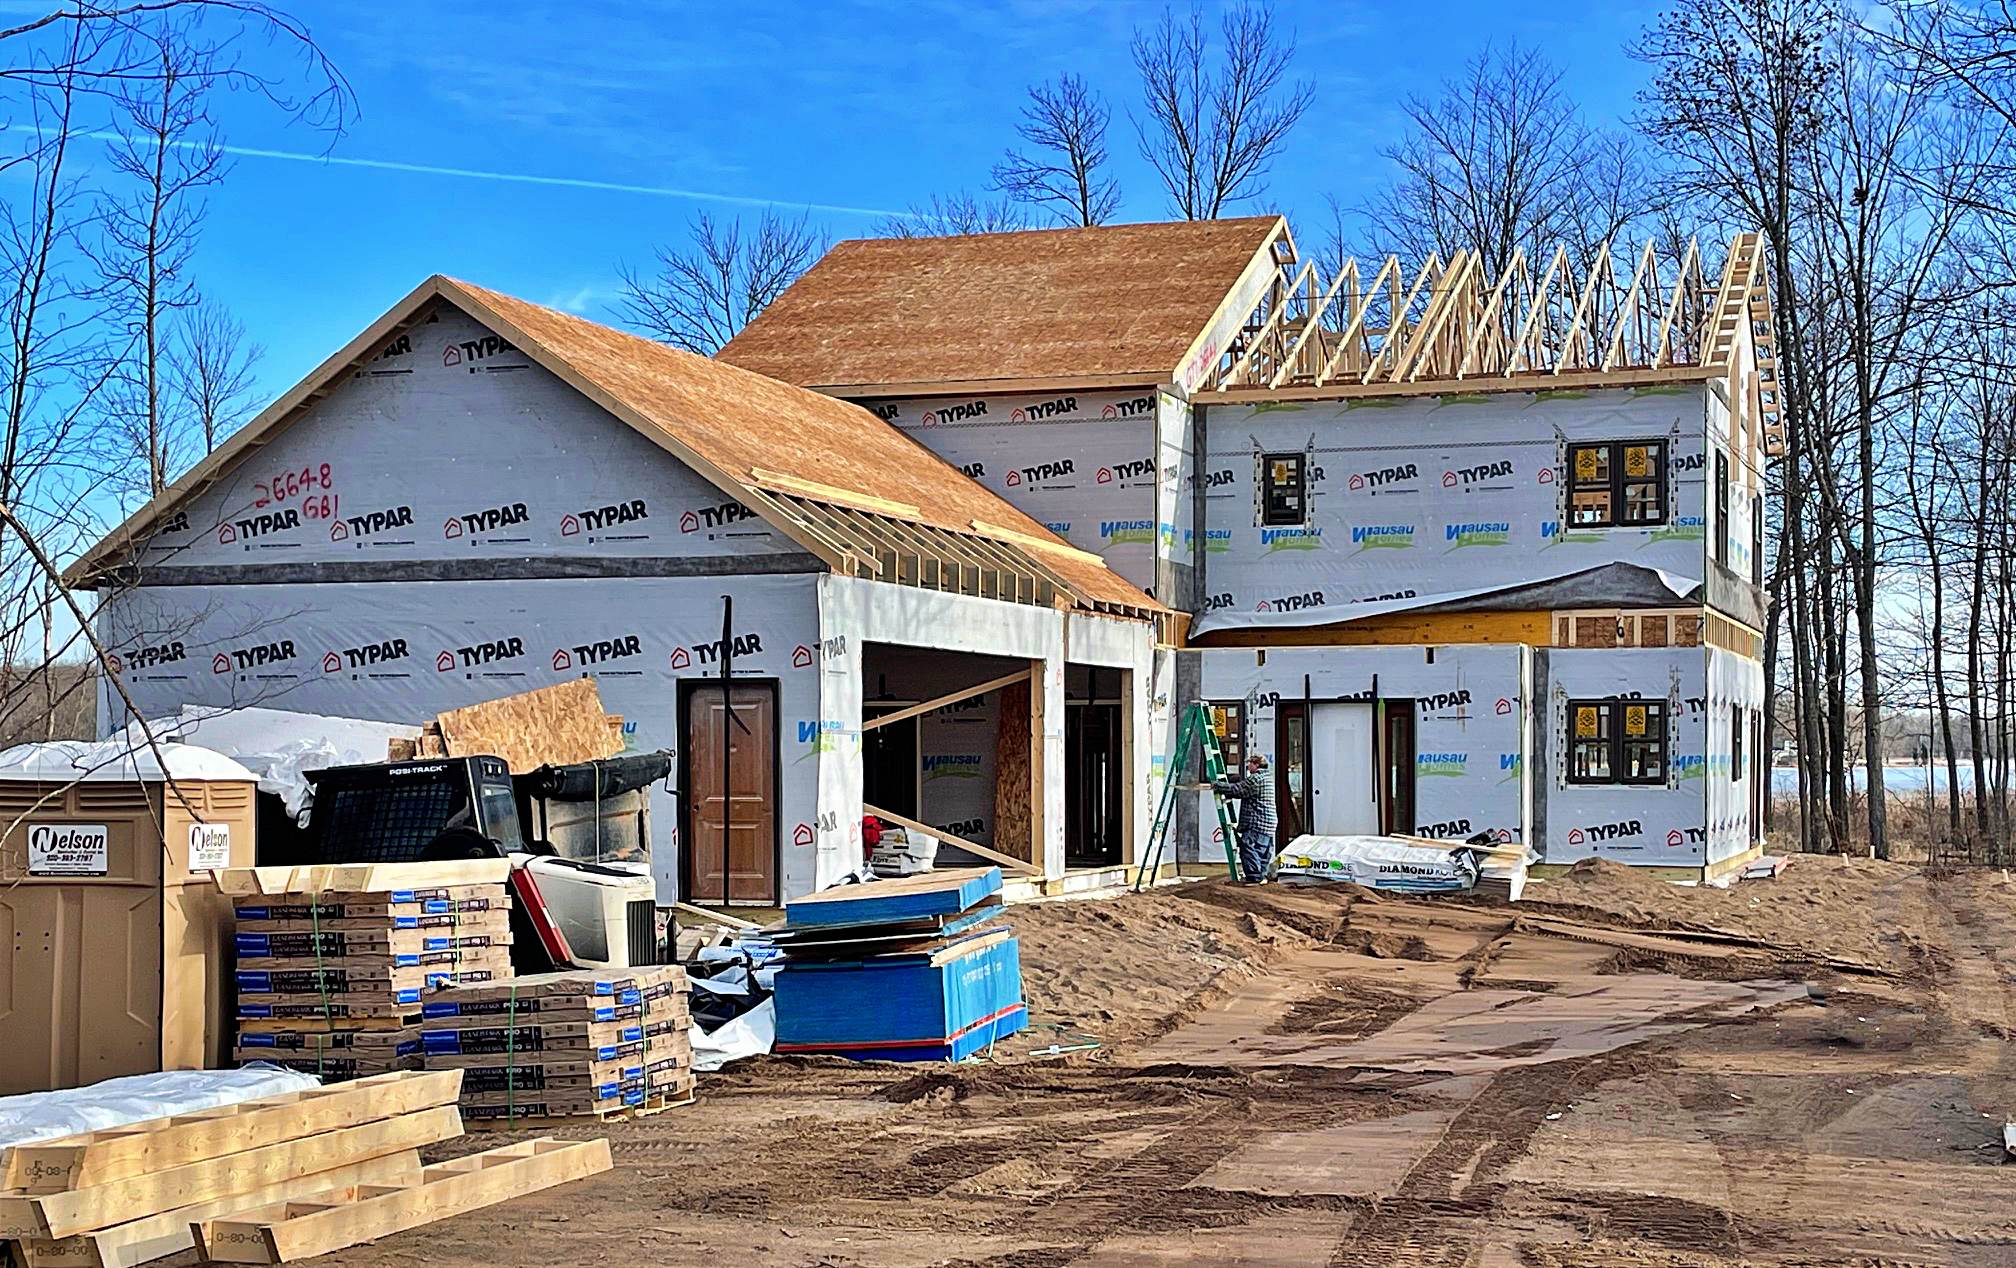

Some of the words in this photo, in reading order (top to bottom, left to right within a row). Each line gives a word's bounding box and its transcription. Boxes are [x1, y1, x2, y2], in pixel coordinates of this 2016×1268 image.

[936, 400, 988, 425] TYPAR
[1024, 397, 1078, 422] TYPAR
[1115, 395, 1155, 418] TYPA
[1022, 459, 1075, 483] TYPAR
[1112, 457, 1155, 481] TYPA
[1364, 464, 1418, 487] TYPAR
[1457, 460, 1513, 485] TYPAR
[236, 509, 301, 541] TYPAR
[346, 505, 414, 538] TYPAR
[460, 503, 529, 534] TYPAR
[578, 499, 649, 532] TYPAR
[1101, 520, 1153, 537] Wausa
[1353, 525, 1414, 543] Wausau
[1446, 522, 1509, 540] Wausau
[123, 641, 187, 671] TYPAR
[231, 640, 297, 670] TYPAR
[343, 638, 410, 669] TYPAR
[456, 637, 526, 667] TYPAR
[572, 634, 642, 666] TYPAR
[1417, 690, 1472, 712] TYPAR
[389, 765, 442, 776] POSI-TRACK
[32, 827, 104, 853] Nelson
[191, 826, 228, 852] Nelson
[1417, 820, 1472, 839] TYPAR
[1585, 820, 1643, 843] TYPAR
